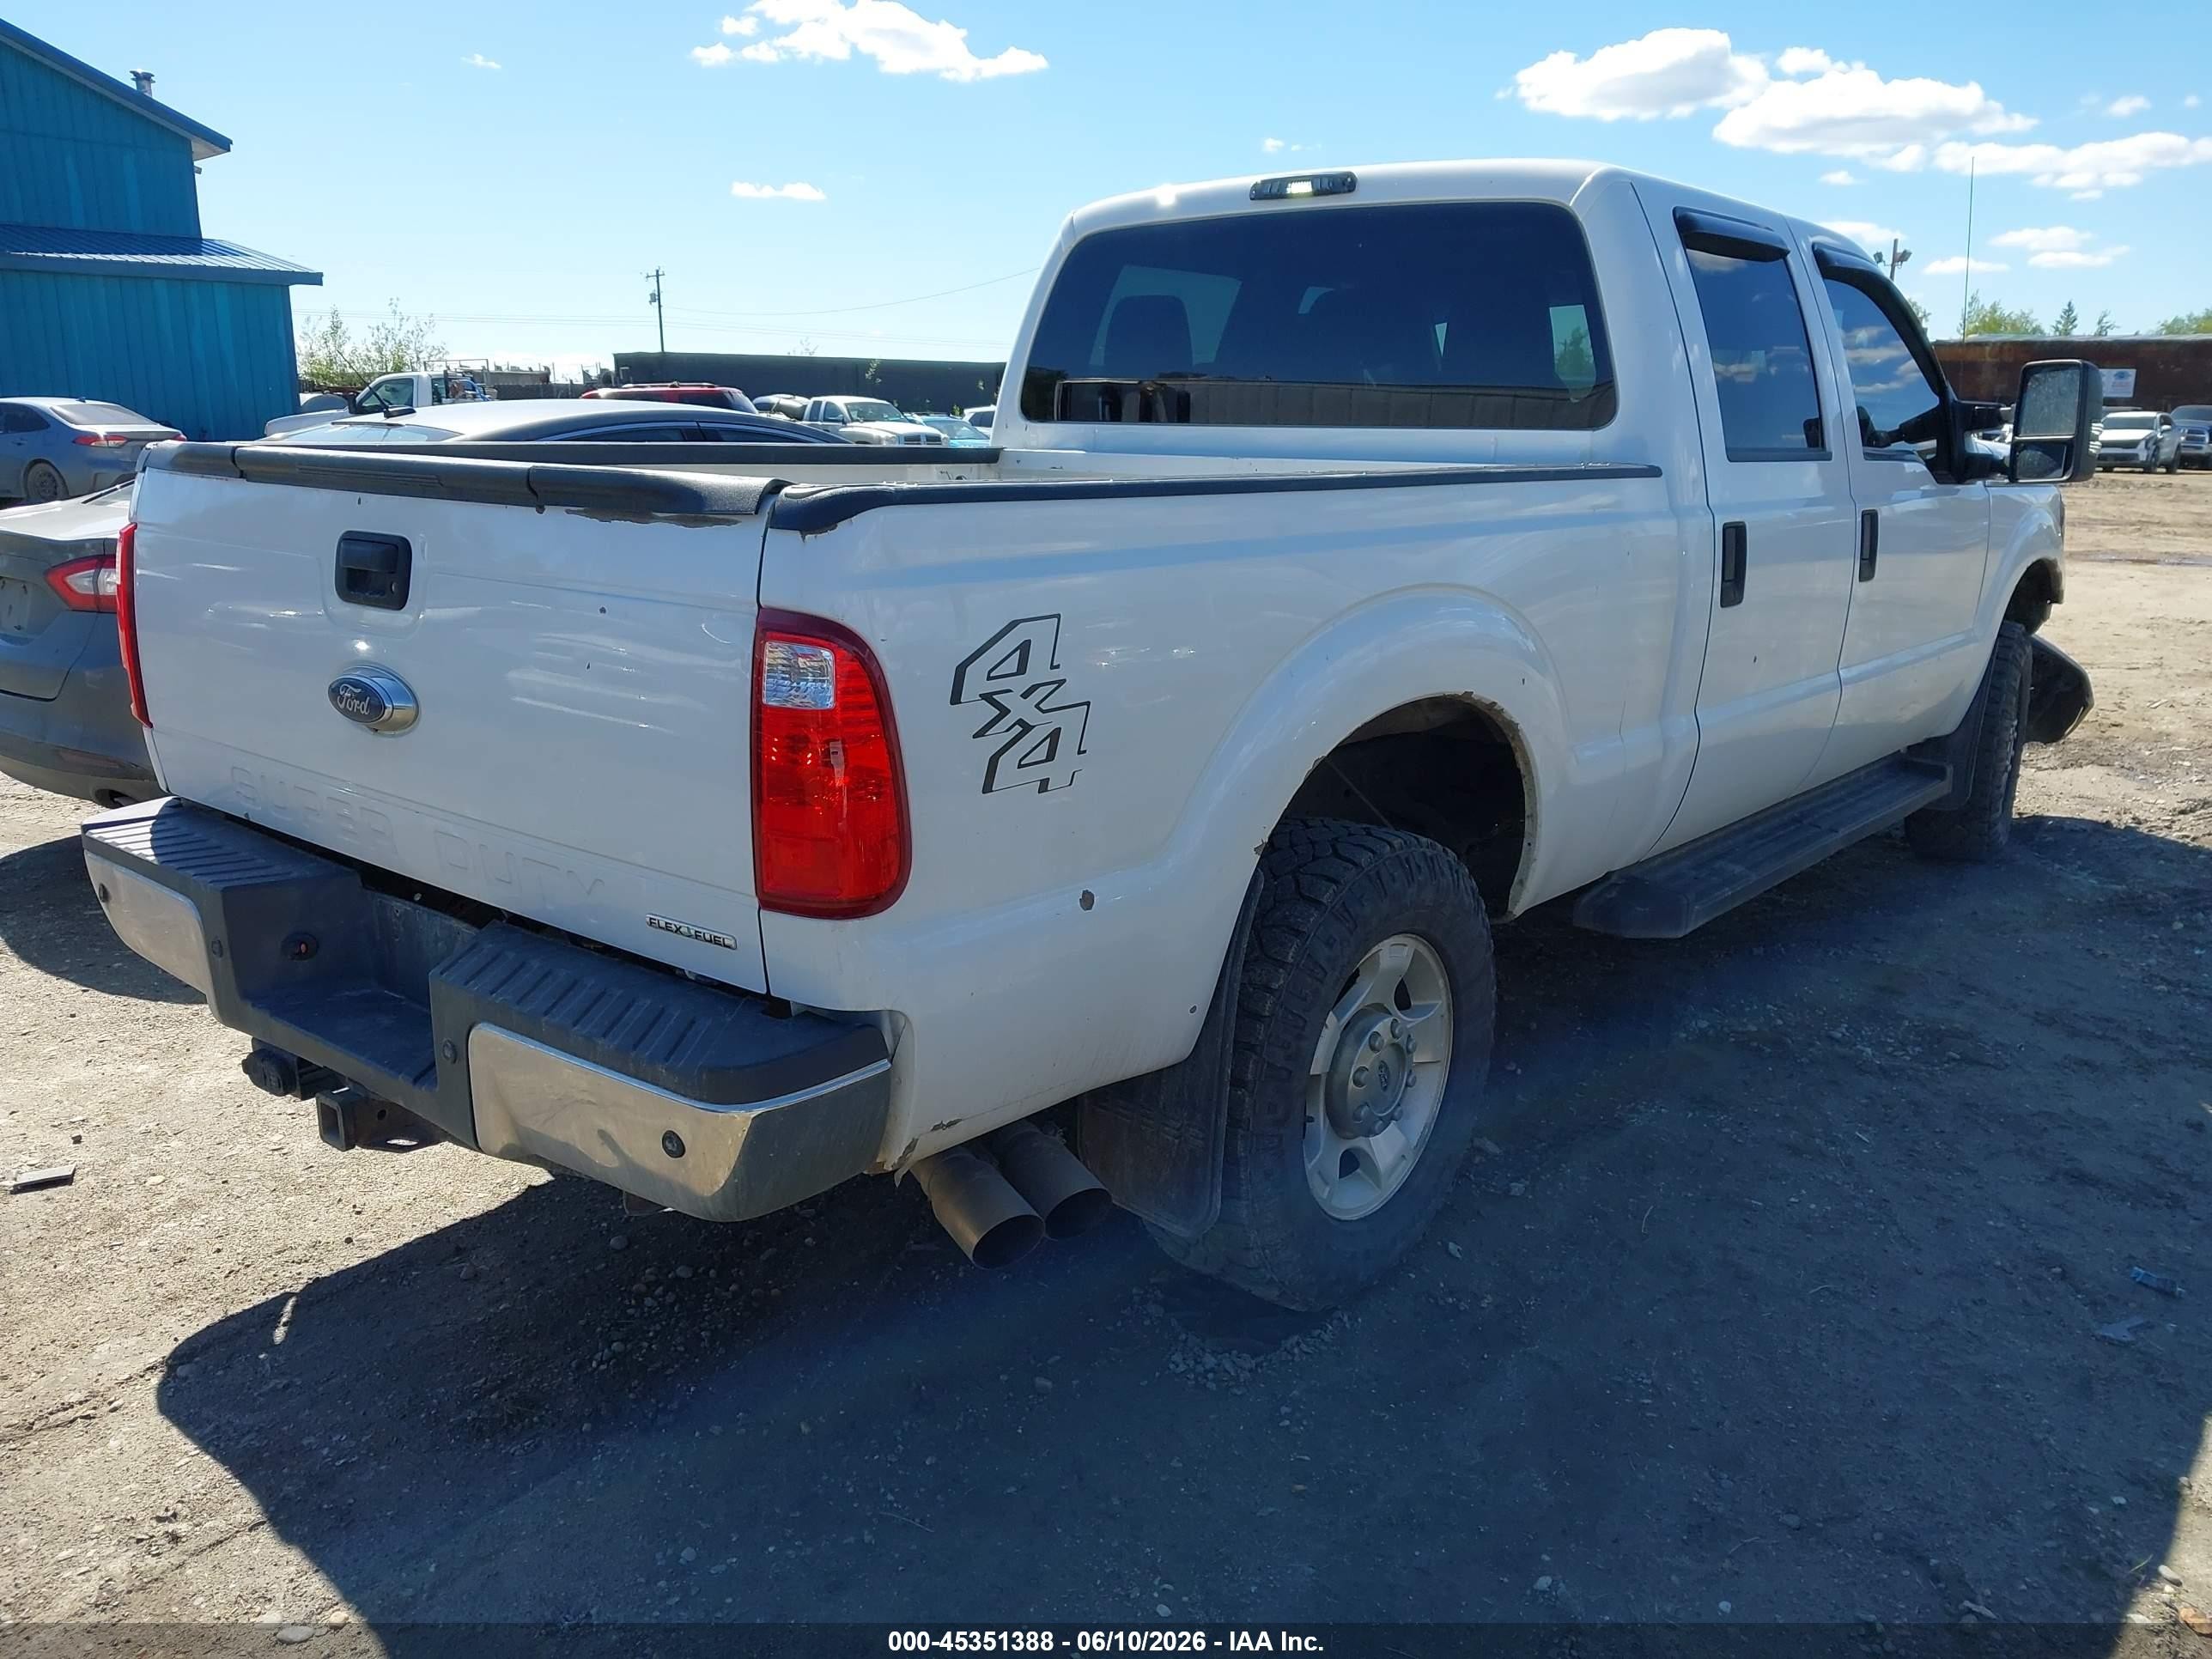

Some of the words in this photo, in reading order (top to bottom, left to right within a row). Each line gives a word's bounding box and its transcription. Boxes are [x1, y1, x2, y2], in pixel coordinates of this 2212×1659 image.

[337, 684, 370, 714] Ford
[230, 765, 402, 859] SUPER
[434, 829, 605, 924] DUTY
[648, 916, 684, 937] FLEX
[693, 929, 734, 950] FUEL
